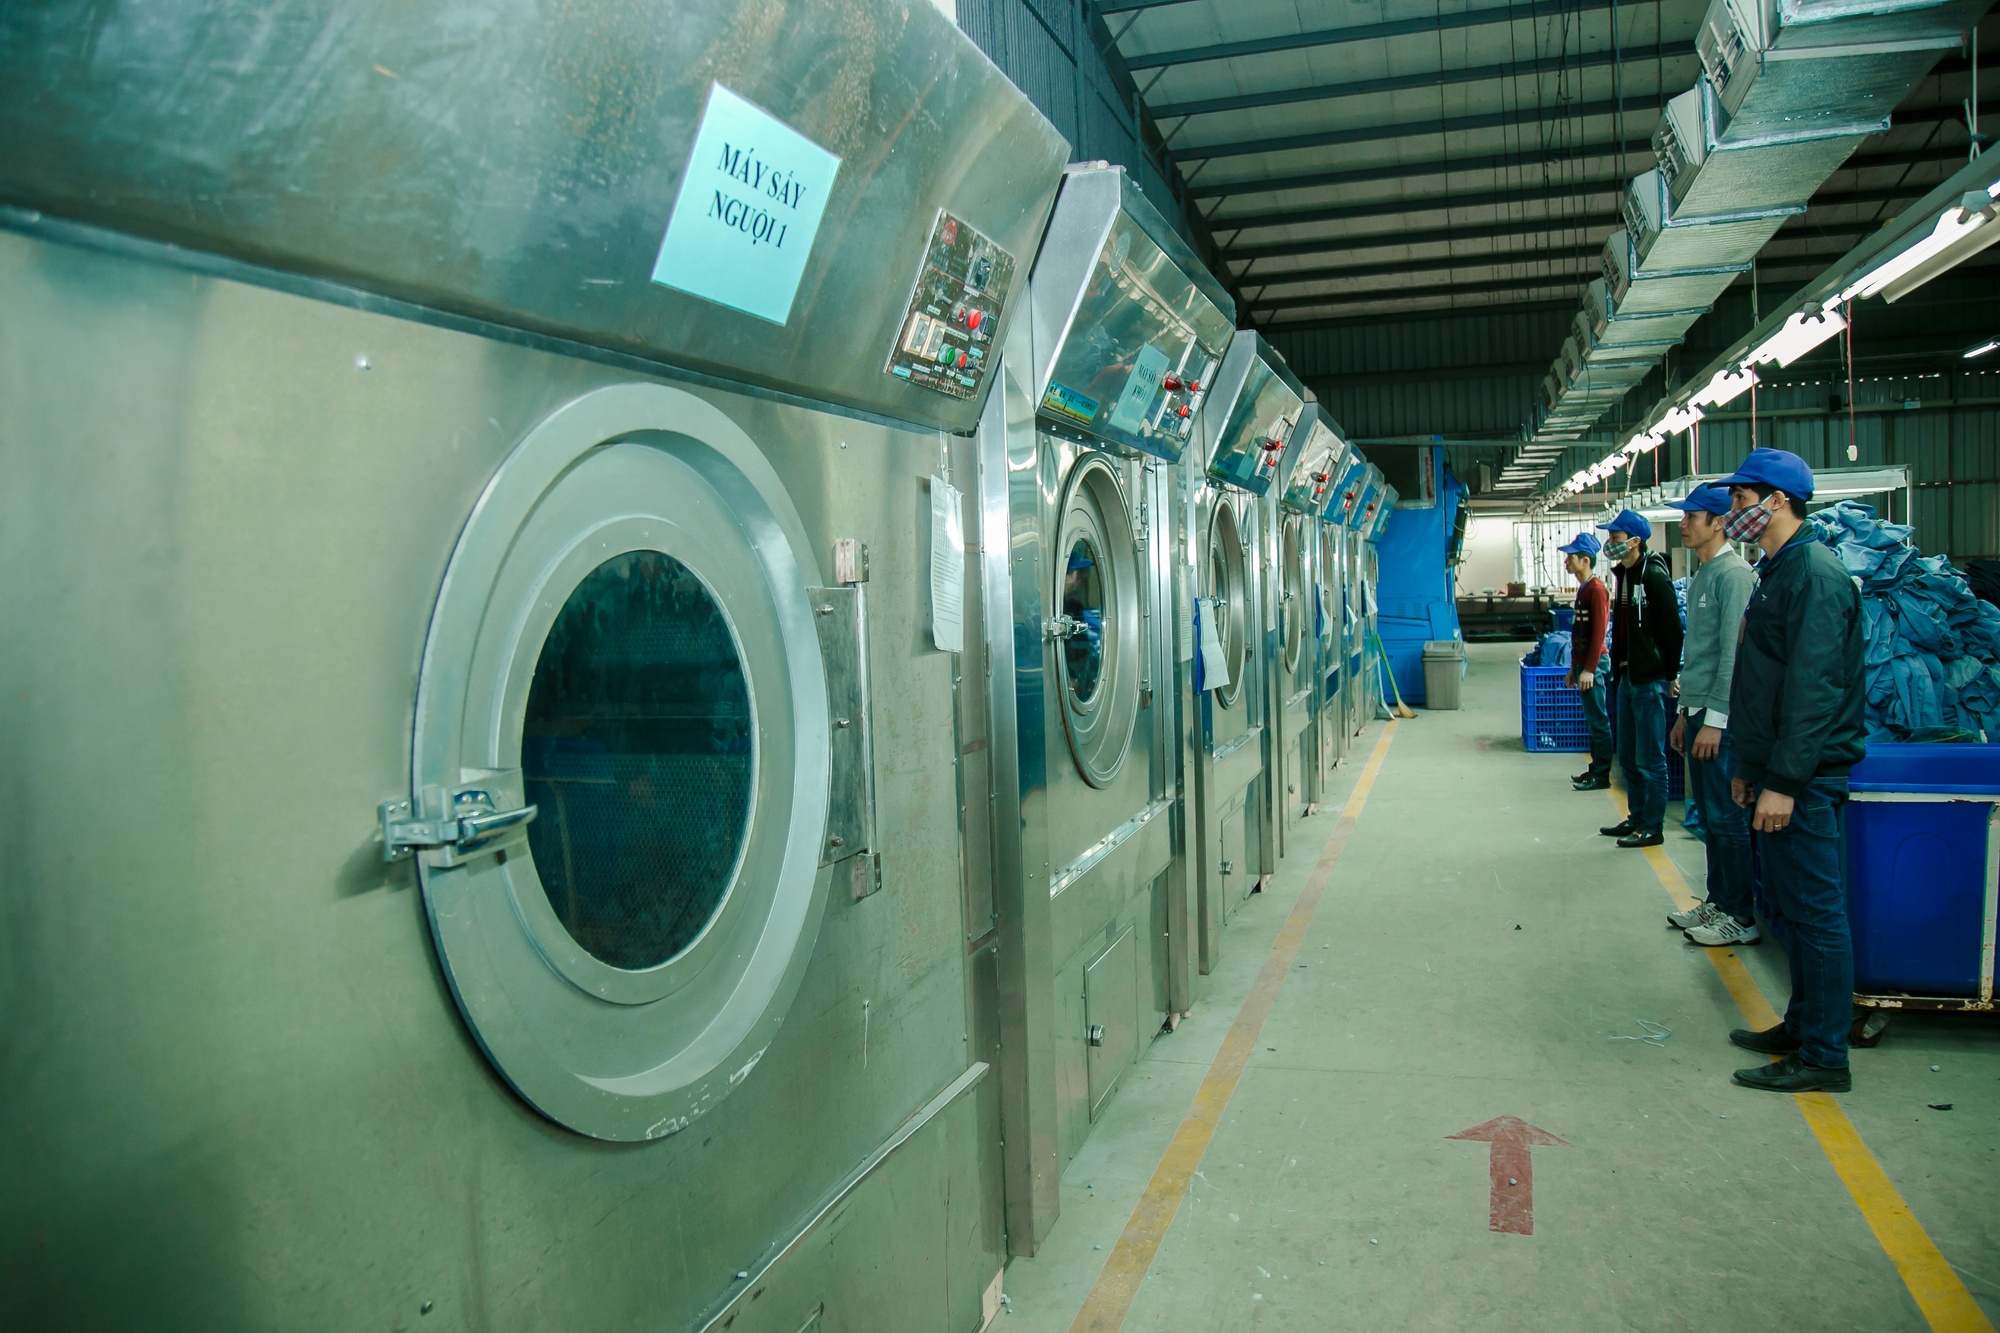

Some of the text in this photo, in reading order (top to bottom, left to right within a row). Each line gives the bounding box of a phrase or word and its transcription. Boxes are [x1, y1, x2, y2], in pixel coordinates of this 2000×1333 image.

[717, 142, 807, 211] MÁY SẤY
[708, 189, 788, 249] NGUỘI 1
